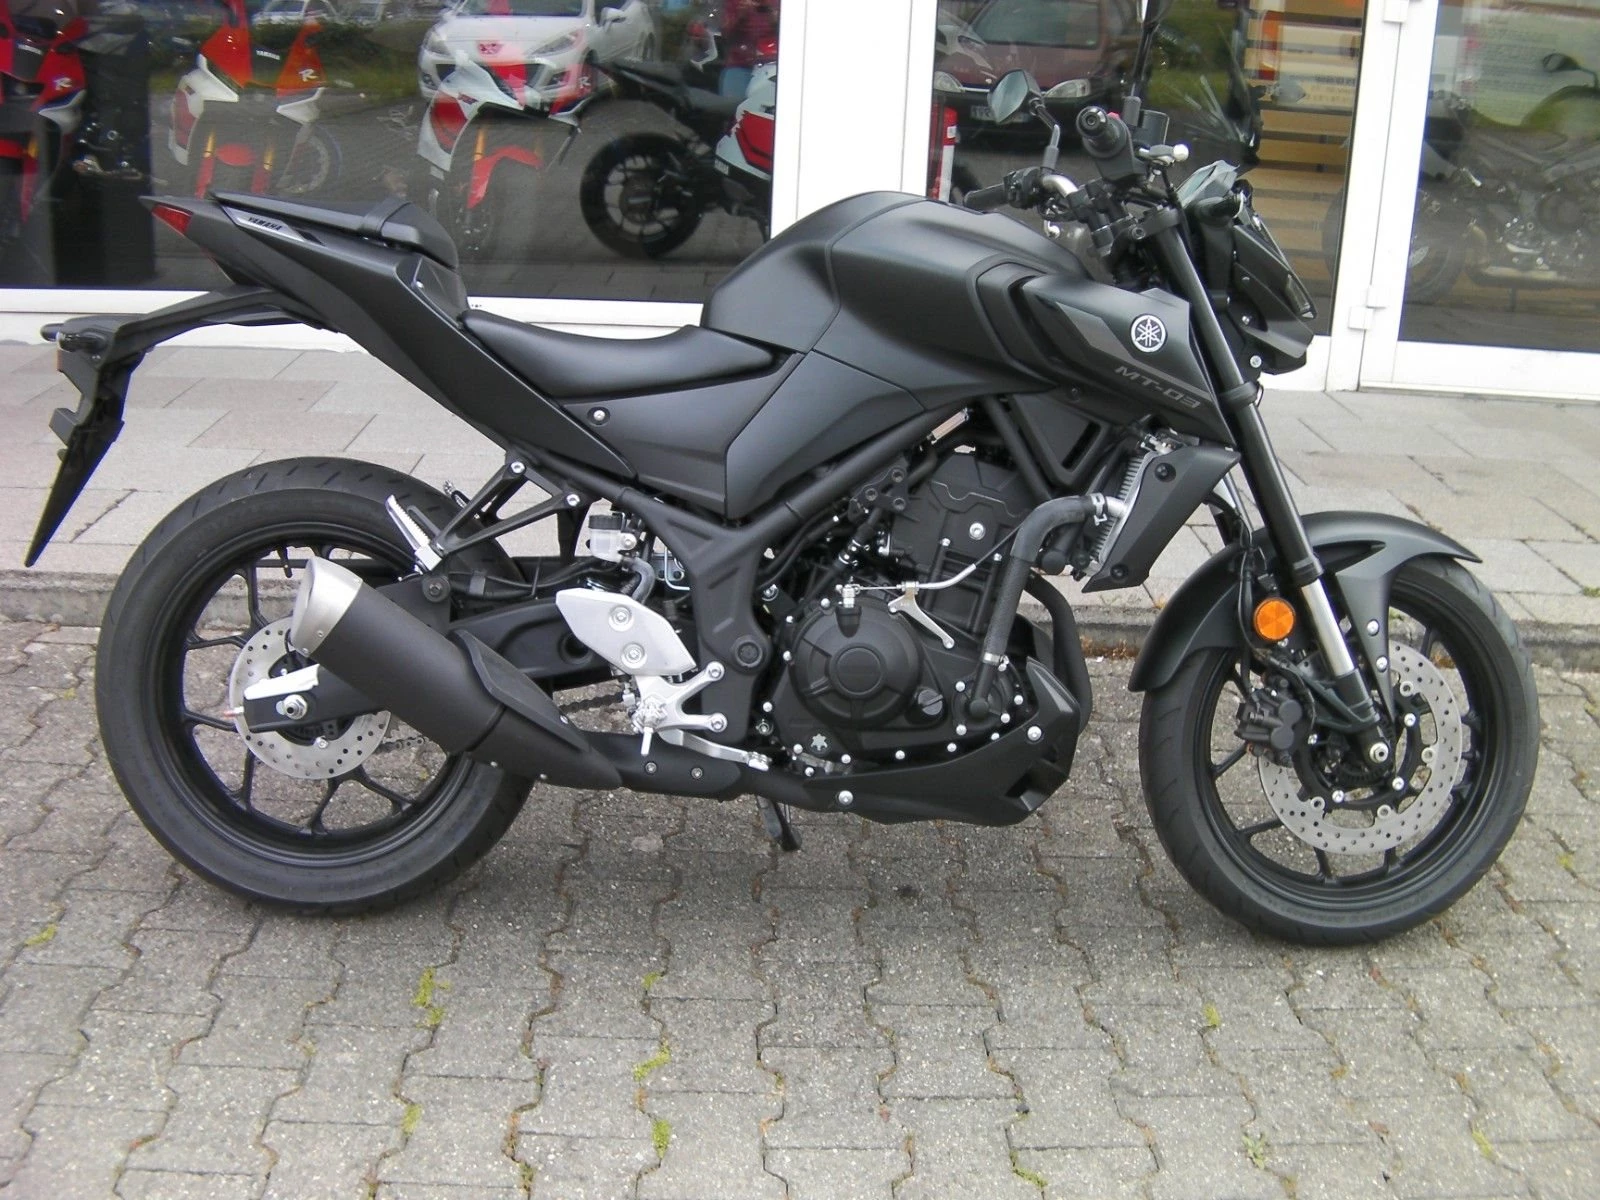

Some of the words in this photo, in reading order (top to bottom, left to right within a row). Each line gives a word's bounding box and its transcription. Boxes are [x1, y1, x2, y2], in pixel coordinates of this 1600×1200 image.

[298, 68, 318, 82] R
[248, 217, 282, 231] YAMAHA
[1114, 366, 1201, 408] MT-03
